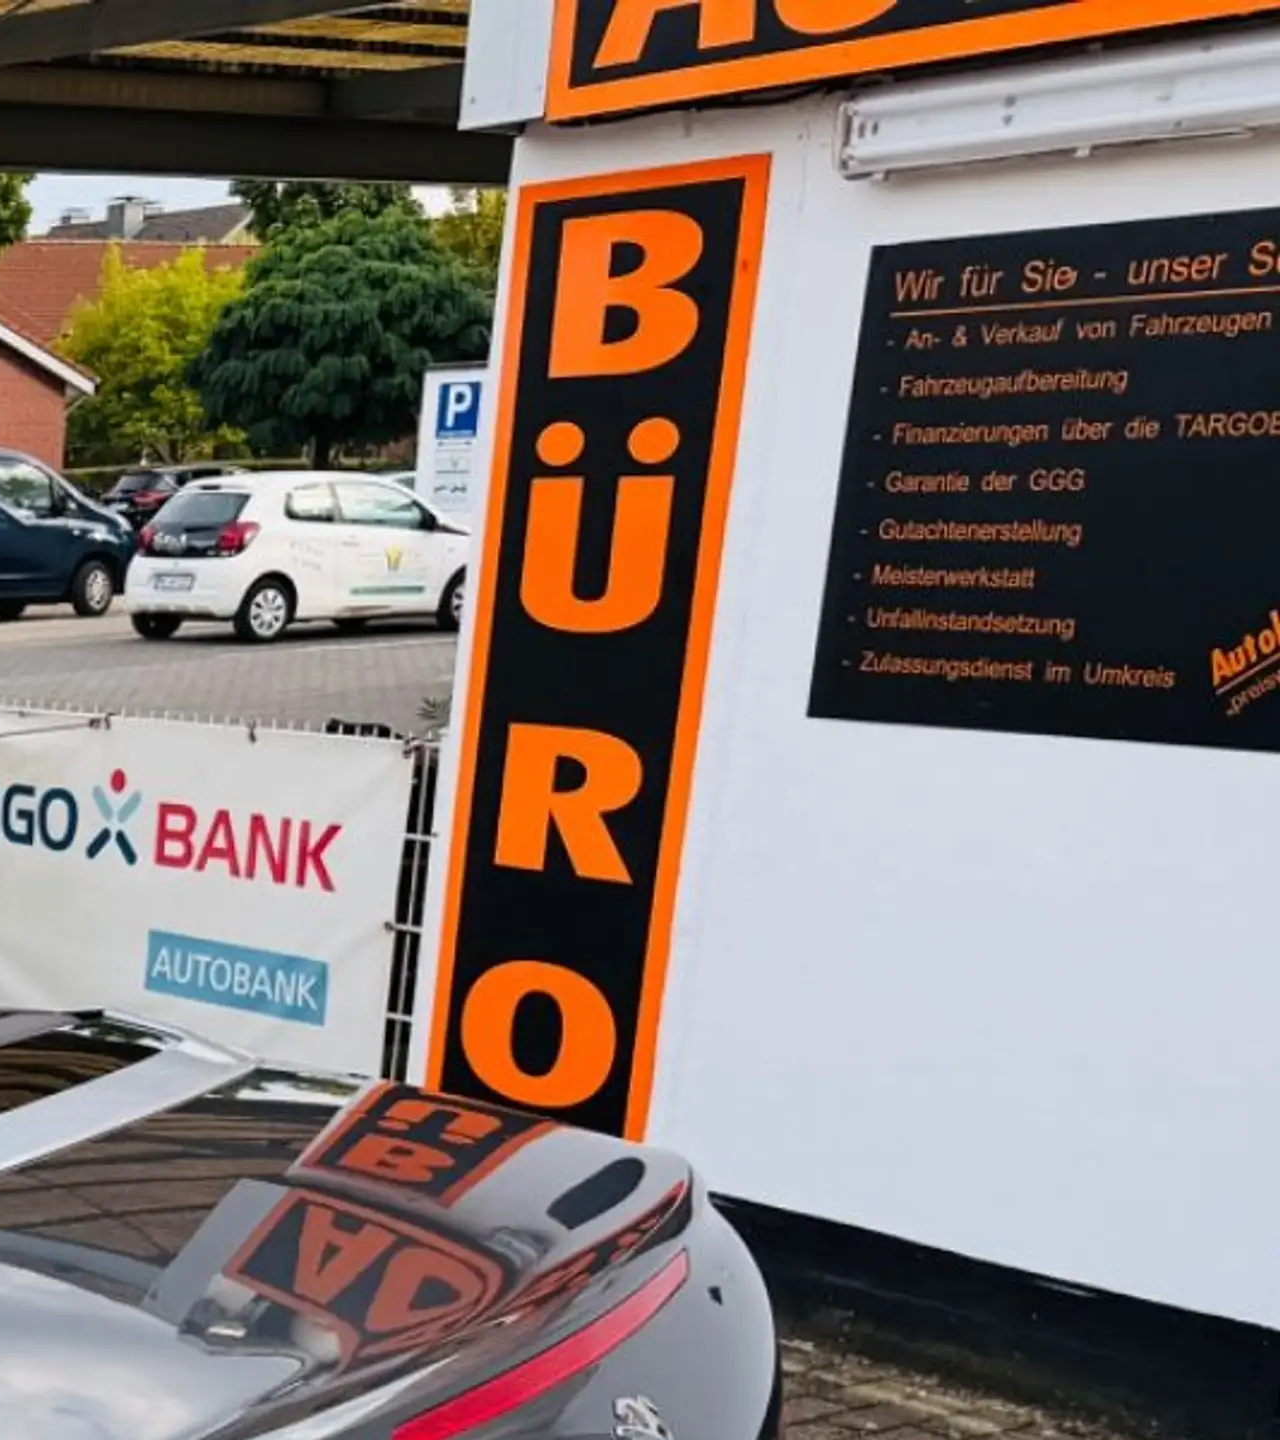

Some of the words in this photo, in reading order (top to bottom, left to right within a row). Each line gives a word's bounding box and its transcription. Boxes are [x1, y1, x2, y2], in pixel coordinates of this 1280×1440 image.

[895, 269, 944, 301] Wir
[960, 264, 1004, 298] für
[1021, 258, 1078, 293] Sie
[1127, 251, 1228, 285] unser
[952, 325, 968, 347] &
[981, 317, 1065, 346] Verkauf
[1076, 320, 1117, 340] von
[1129, 310, 1273, 338] Fahrzeugen
[898, 366, 1129, 399] Fahrzeugaufbereitung
[892, 420, 1049, 447] Finanzierungen
[1061, 417, 1113, 441] über
[1124, 415, 1161, 439] die
[885, 470, 970, 493] Garantie
[981, 470, 1018, 491] der
[1029, 468, 1086, 491] GGG
[878, 518, 1083, 548] Gutachtenerstellung
[872, 563, 1037, 588] Meisterwerkstatt
[867, 607, 1077, 641] Unfallinstandsetzung
[461, 210, 704, 1108] BÜRO
[858, 650, 1034, 682] Zulassungsdienst
[1044, 661, 1072, 682] im
[1084, 663, 1177, 689] Umkreis
[154, 801, 342, 892] BANK
[151, 946, 320, 1010] AUTOBANK
